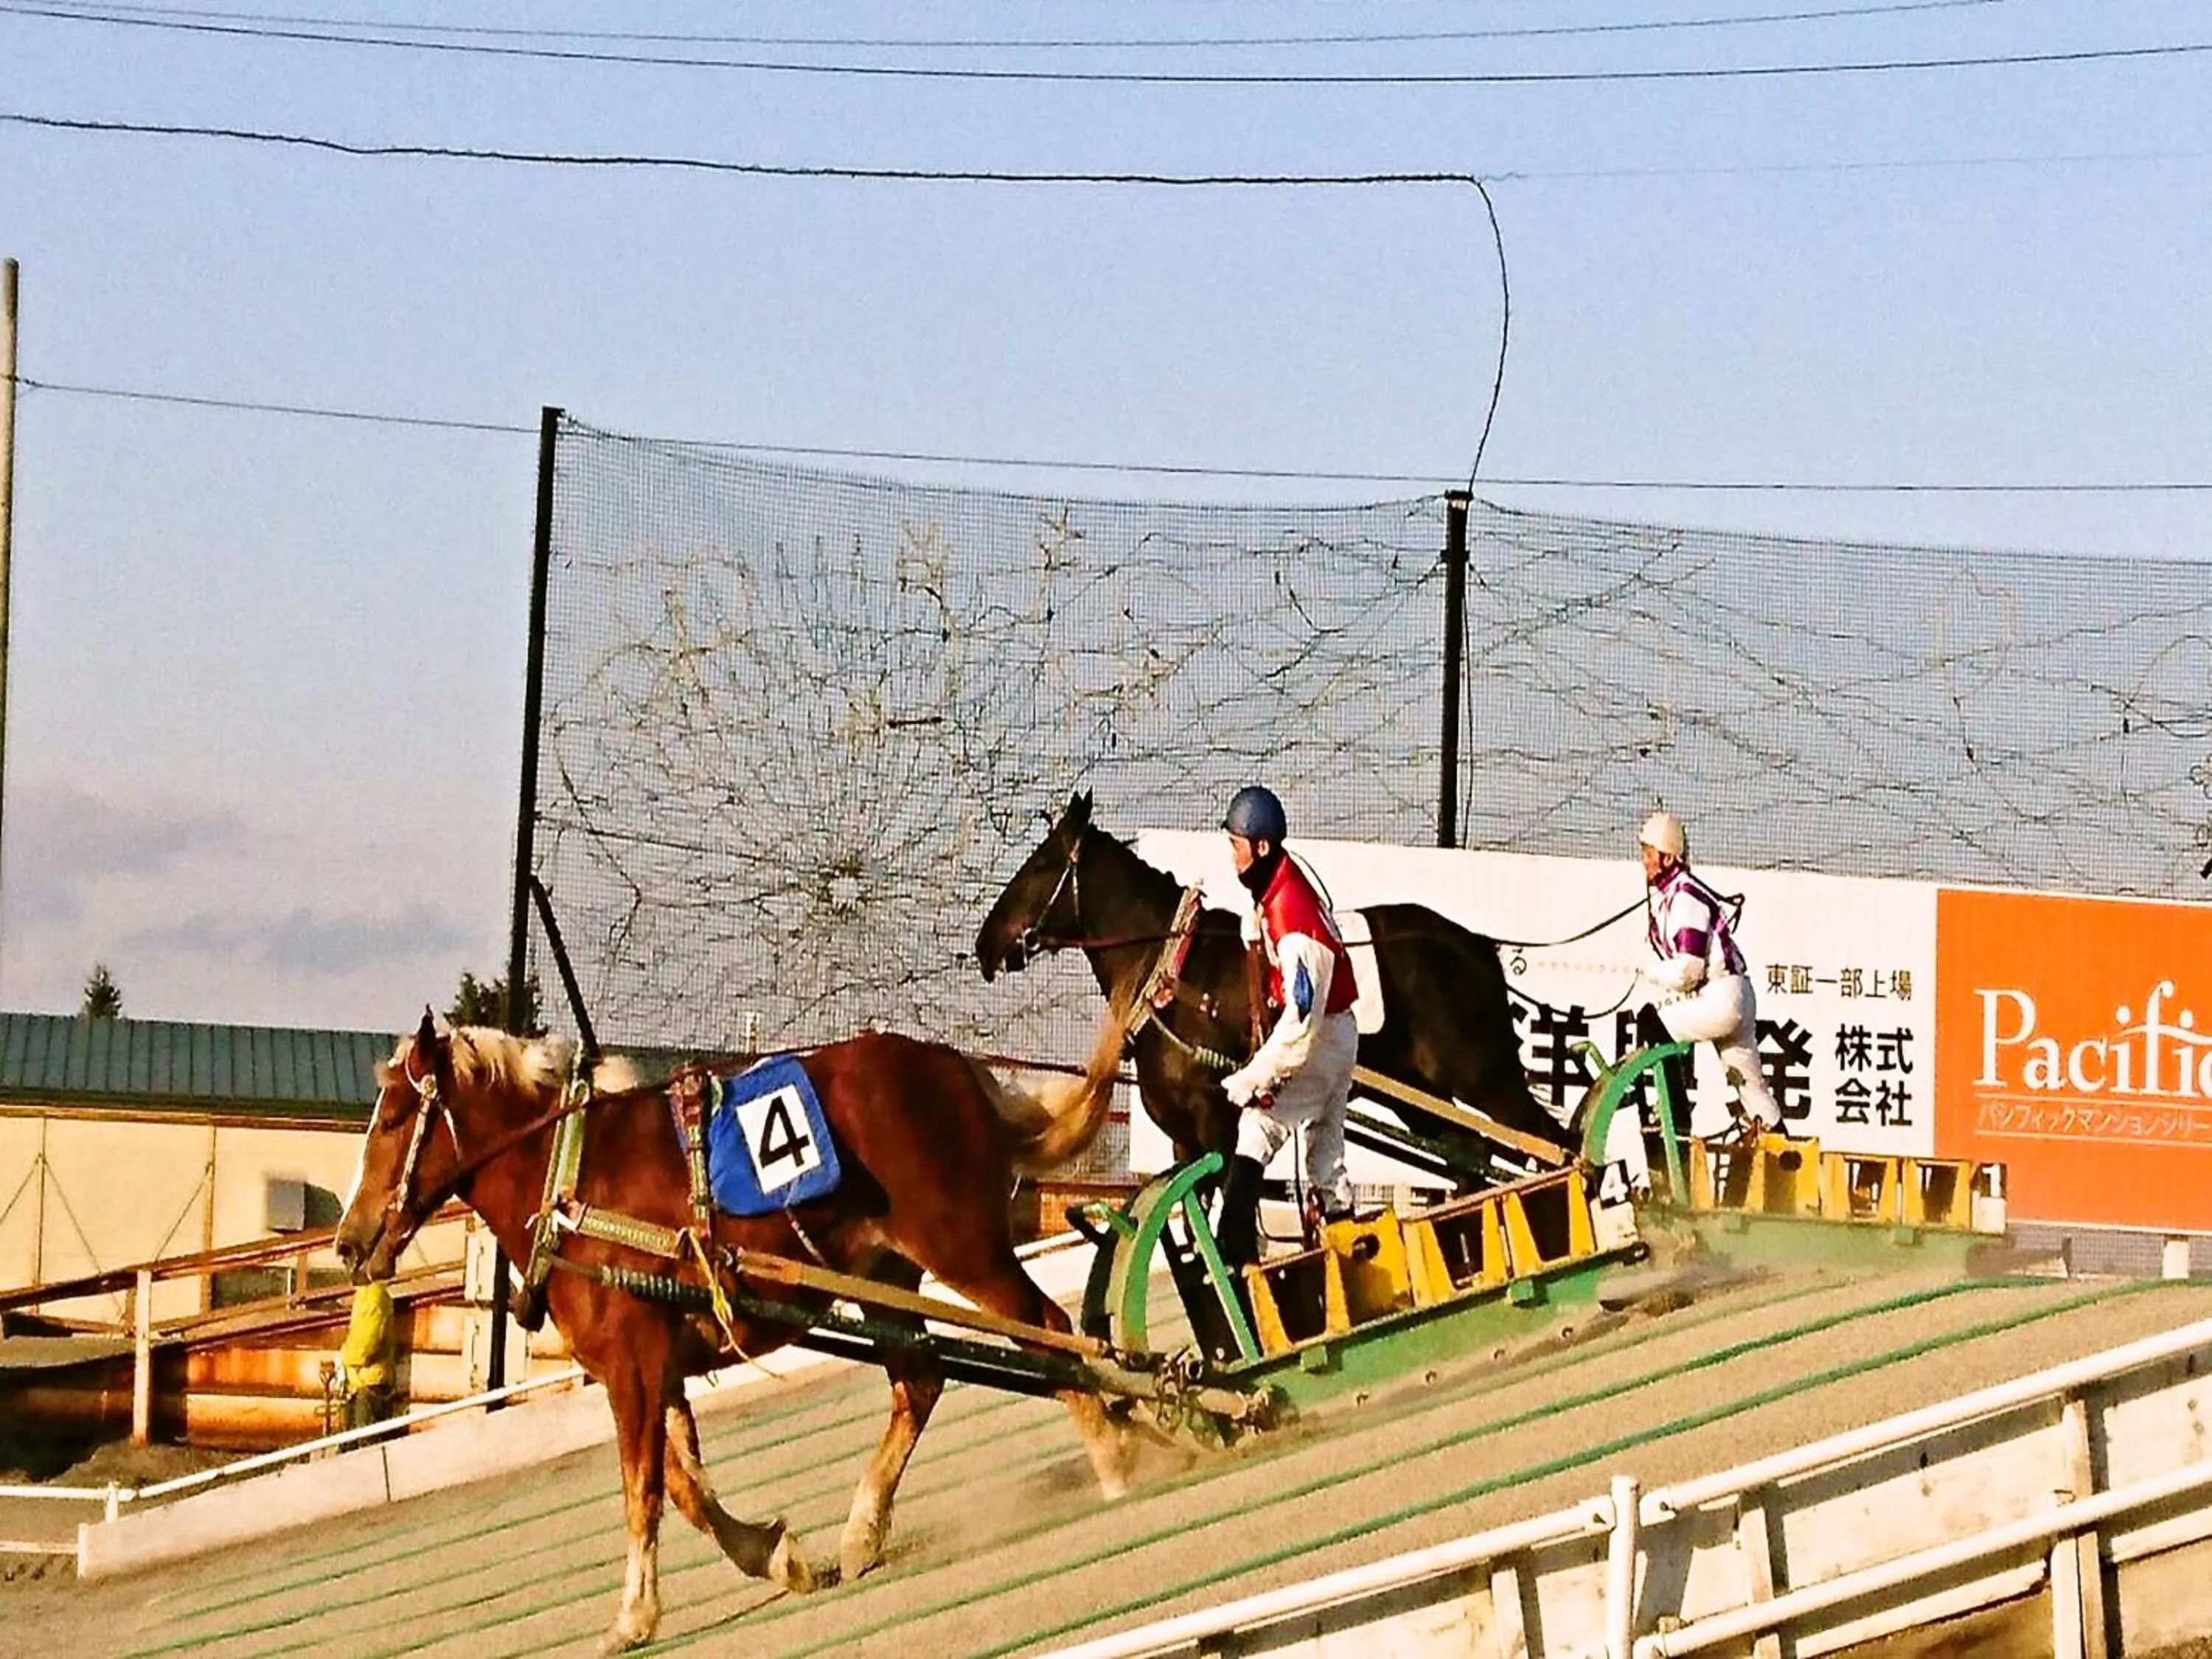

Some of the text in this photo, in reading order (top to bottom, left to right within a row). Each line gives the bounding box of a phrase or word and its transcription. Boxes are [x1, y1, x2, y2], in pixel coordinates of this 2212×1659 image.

[1766, 964, 1911, 1001] 東証一部上場
[1834, 1023, 1913, 1074] 株式
[1834, 1077, 1913, 1127] 会社
[758, 1095, 810, 1169] 4
[1599, 1164, 1629, 1203] 4
[1981, 1164, 2001, 1198] 1
